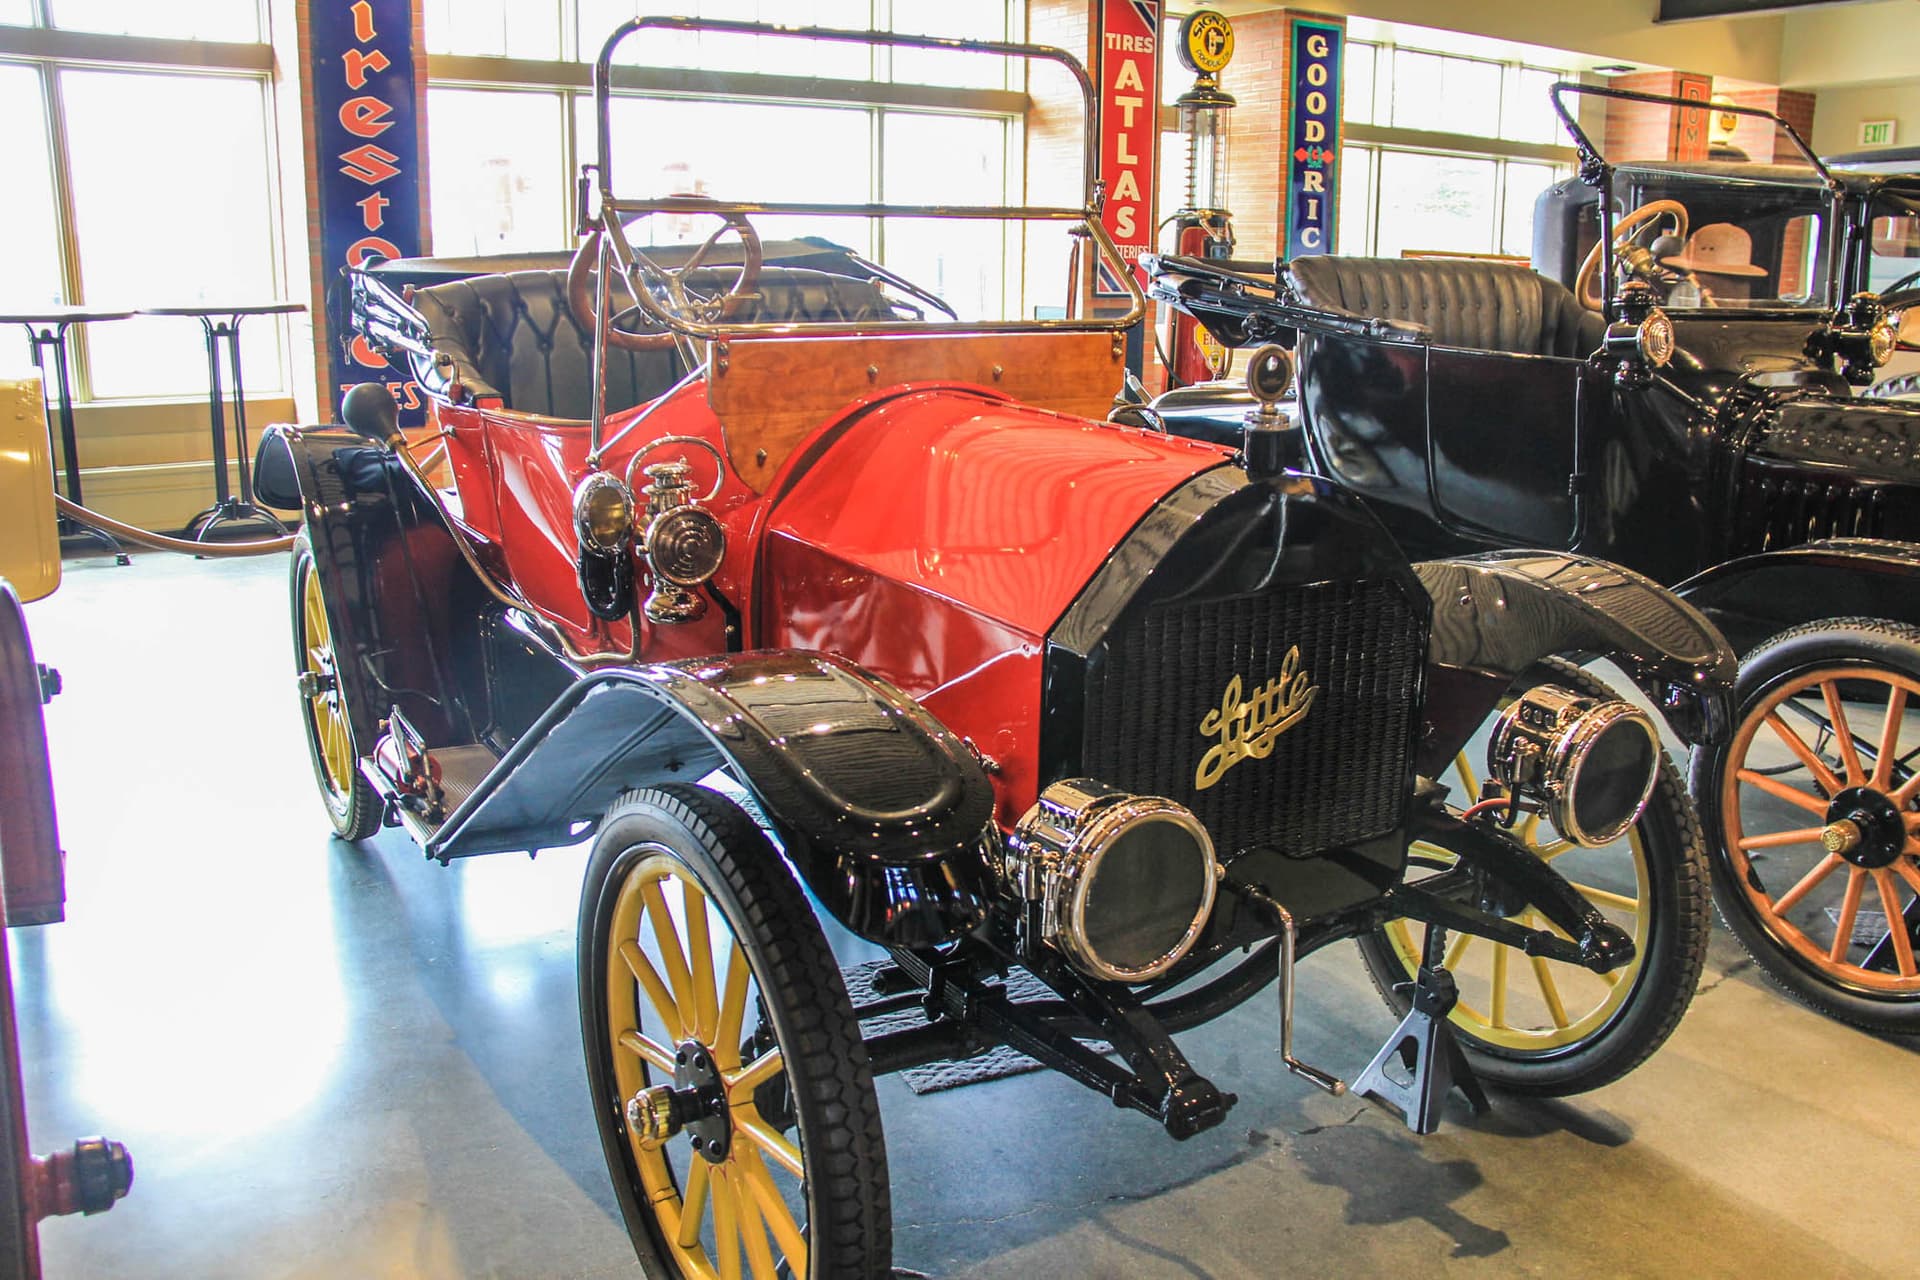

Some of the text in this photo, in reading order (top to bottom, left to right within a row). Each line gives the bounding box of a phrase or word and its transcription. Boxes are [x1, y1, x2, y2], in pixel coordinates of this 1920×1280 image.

[1193, 15, 1230, 38] SIGNAL
[1105, 32, 1153, 54] TIRES
[1863, 124, 1889, 144] EXIT
[1112, 59, 1145, 239] ATLAS
[1195, 645, 1320, 790] Little
